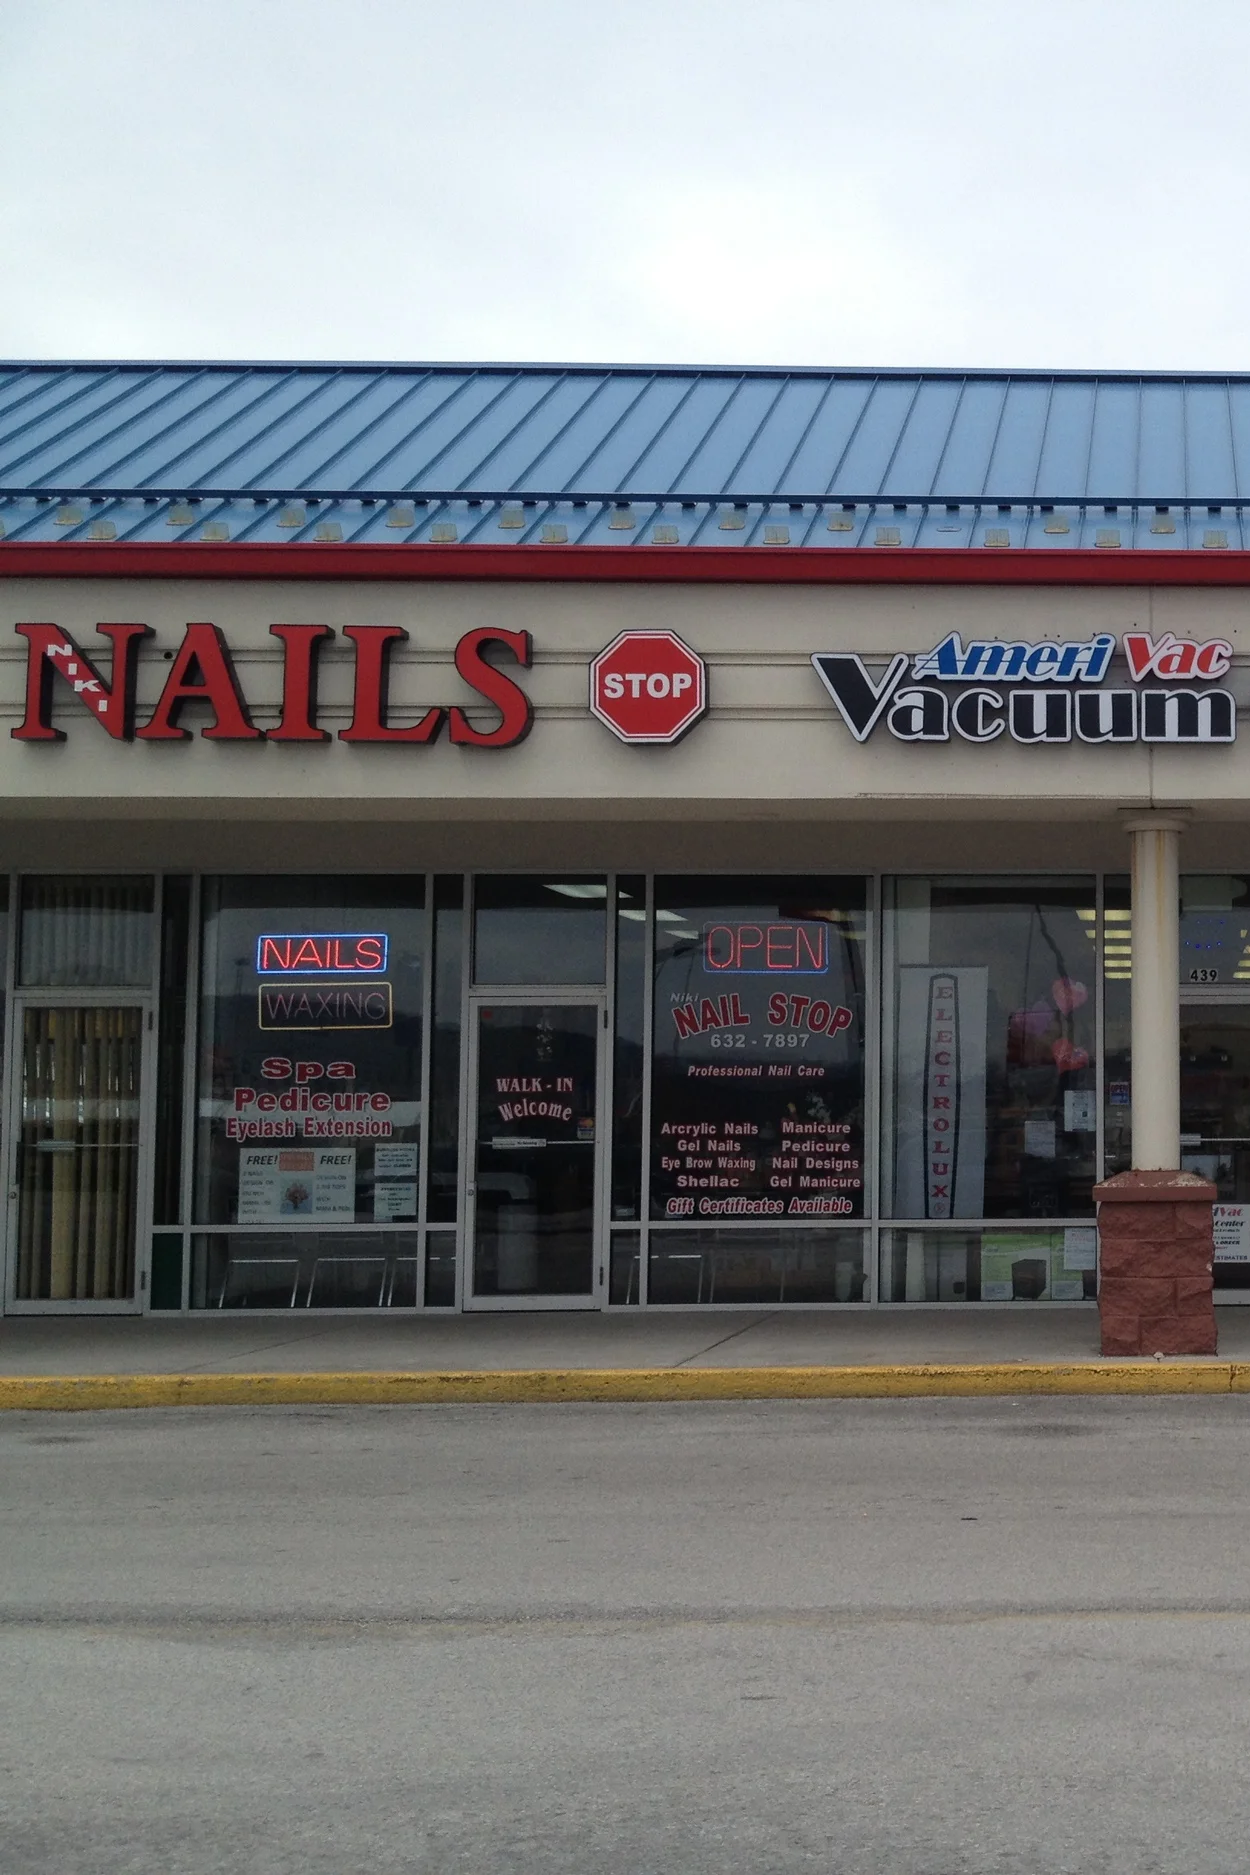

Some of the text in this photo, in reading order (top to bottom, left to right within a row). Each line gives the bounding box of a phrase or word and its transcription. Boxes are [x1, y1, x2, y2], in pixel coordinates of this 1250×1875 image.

[912, 630, 1234, 682] Ameri Vac
[11, 622, 533, 747] NAILS
[47, 644, 107, 711] NIKI
[603, 671, 692, 699] STOP
[810, 652, 1238, 743] Vacuum
[262, 938, 382, 970] NAILS
[707, 926, 823, 969] OPEN
[1190, 969, 1217, 982] 439
[266, 992, 386, 1020] WAXING
[670, 993, 699, 1003] Niki
[672, 992, 853, 1039] NAIL STOP
[710, 1034, 746, 1048] 632
[763, 1034, 811, 1048] 7897
[261, 1057, 357, 1084] Spa
[687, 1065, 825, 1077] Professional Nail Care
[496, 1077, 542, 1092] WALK
[556, 1077, 574, 1092] IN
[932, 986, 953, 1198] ELECTROLUX
[234, 1087, 392, 1112] Pedicure
[498, 1098, 573, 1122] Welcome
[226, 1117, 393, 1142] Eyelash Extension
[661, 1122, 759, 1137] Arcrylic Nails
[782, 1122, 851, 1134] Manicure
[677, 1140, 741, 1152] Gel Nails
[781, 1140, 851, 1152] Pedicure
[246, 1155, 278, 1165] FREE!
[320, 1155, 352, 1165] FREE!
[661, 1157, 756, 1171] Eye Brow Waxing
[772, 1157, 859, 1171] Nail Designs
[677, 1175, 740, 1188] Shellac
[770, 1175, 861, 1188] Gel Manicure
[667, 1197, 853, 1214] Gift Certificates Available
